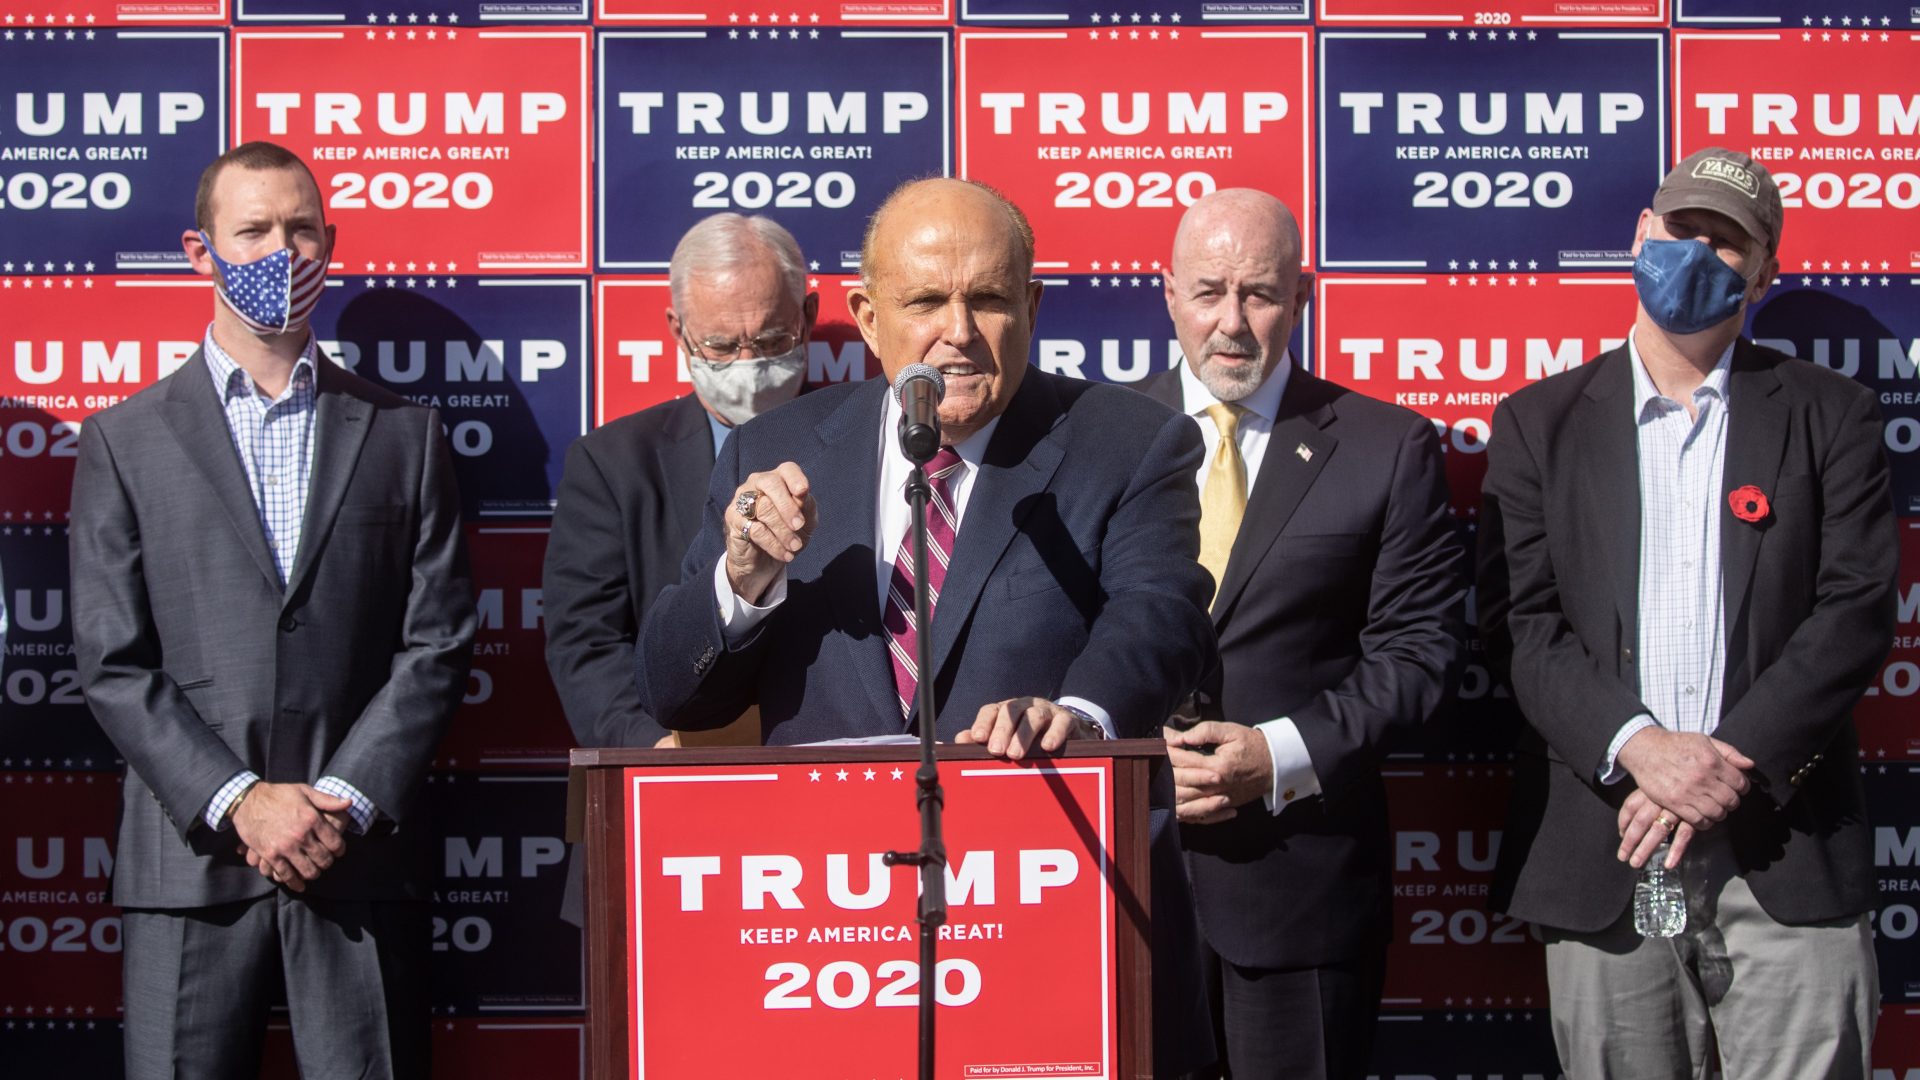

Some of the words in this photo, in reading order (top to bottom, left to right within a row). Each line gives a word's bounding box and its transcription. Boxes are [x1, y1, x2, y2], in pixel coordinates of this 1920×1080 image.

[1475, 13, 1511, 24] 2020
[17, 93, 204, 136] UMP
[257, 93, 566, 135] TRUMP
[619, 92, 928, 134] TRUMP
[981, 92, 1288, 135] TRUMP
[1340, 93, 1644, 135] TRUMP
[1696, 94, 1920, 136] TRUM
[2, 147, 79, 160] AMERICA
[86, 147, 147, 160] GREAT!
[314, 147, 357, 160] KEEP
[363, 147, 441, 159] AMERICA
[448, 147, 509, 159] GREAT!
[677, 147, 720, 159] KEEP
[726, 146, 804, 159] AMERICA
[810, 146, 871, 159] GREAT!
[1038, 147, 1081, 159] KEEP
[1088, 147, 1165, 159] AMERICA
[1171, 146, 1232, 159] GREAT!
[1397, 147, 1439, 159] KEEP
[1445, 147, 1522, 159] AMERICA
[1528, 147, 1588, 159] GREAT!
[1752, 148, 1793, 159] KEEP
[1800, 148, 1874, 160] AMERICA
[0, 173, 131, 209] 020
[330, 172, 492, 209] 2020
[693, 172, 855, 208] 2020
[1055, 171, 1217, 208] 2020
[1413, 172, 1572, 208] 2020
[1705, 160, 1753, 187] YARDS
[1777, 172, 1920, 209] 2020
[14, 341, 200, 384] UMP
[317, 339, 567, 383] RUMP
[1339, 338, 1627, 381] TRUM
[1, 395, 78, 408] AMERICA
[448, 395, 509, 407] GREAT!
[1395, 392, 1439, 406] KEEP
[0, 420, 79, 458] 02
[473, 643, 510, 655] EAT!
[0, 668, 85, 705] 02
[2, 891, 80, 904] AMERICA
[447, 891, 509, 903] GREAT!
[662, 849, 1079, 911] TRUMP
[1394, 884, 1436, 897] KEEP
[1442, 884, 1489, 896] AMER
[1878, 879, 1920, 891] GREA
[0, 916, 123, 953] 020
[740, 928, 799, 944] KEEP
[807, 925, 912, 943] AMERICA
[939, 923, 1004, 940] REAT!
[763, 958, 982, 1009] 2020
